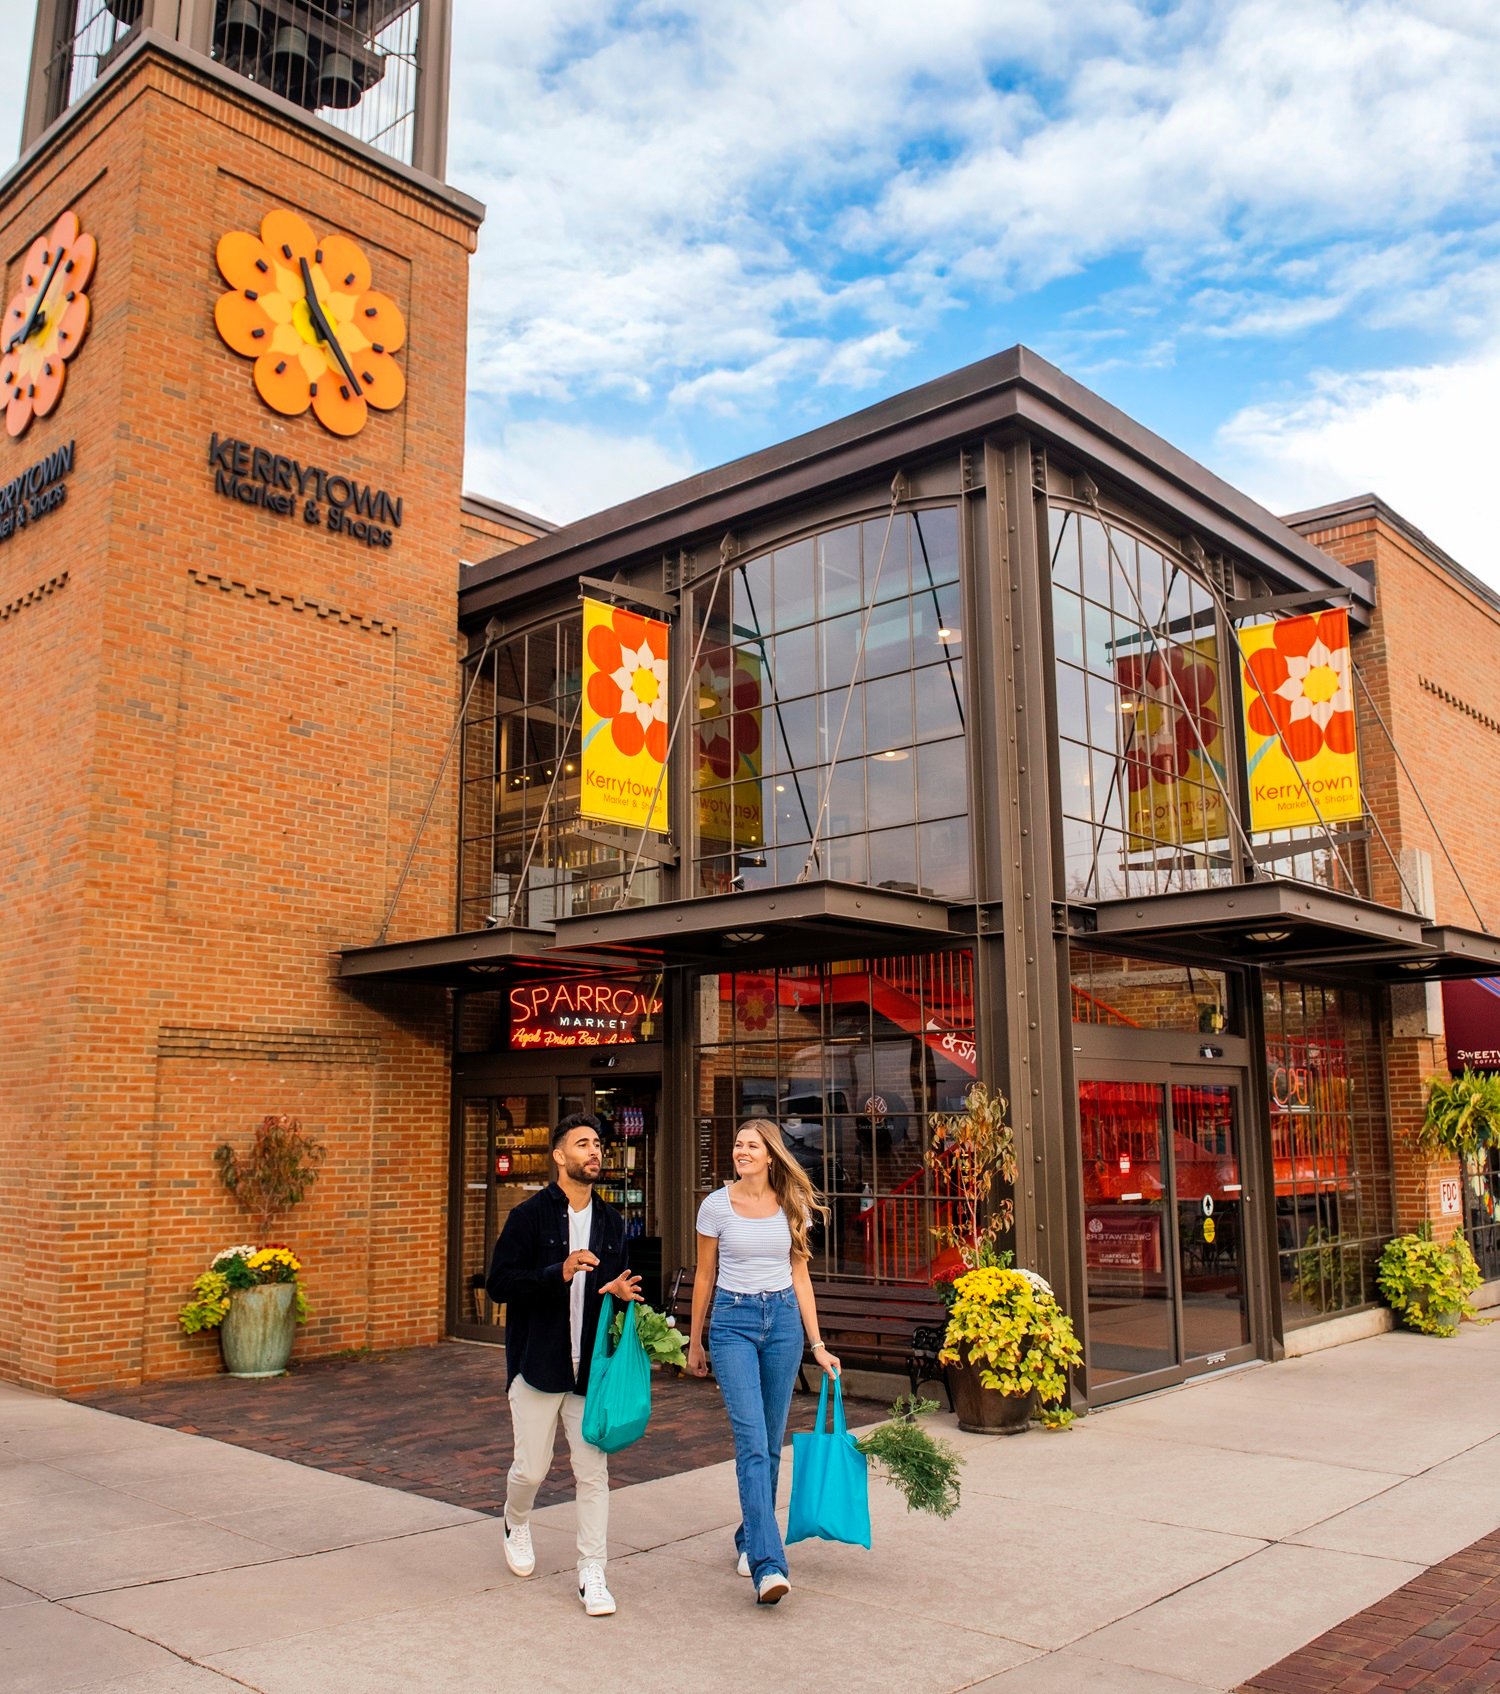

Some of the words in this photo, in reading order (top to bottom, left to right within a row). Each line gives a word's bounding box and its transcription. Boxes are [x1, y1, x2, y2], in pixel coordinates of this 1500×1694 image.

[208, 432, 403, 528] KERRYTOWN
[16, 503, 26, 528] &
[215, 470, 296, 517] Market
[303, 499, 321, 525] &
[327, 507, 393, 548] Shops
[585, 768, 663, 801] Kerrytown
[1254, 775, 1353, 802] Kerrytown
[603, 793, 629, 807] Market
[632, 799, 638, 808] &
[1277, 800, 1310, 812] Market
[1314, 798, 1320, 806] &
[1325, 793, 1354, 805] Shops
[559, 1016, 628, 1030] MARKET
[1442, 1182, 1458, 1202] FDC
